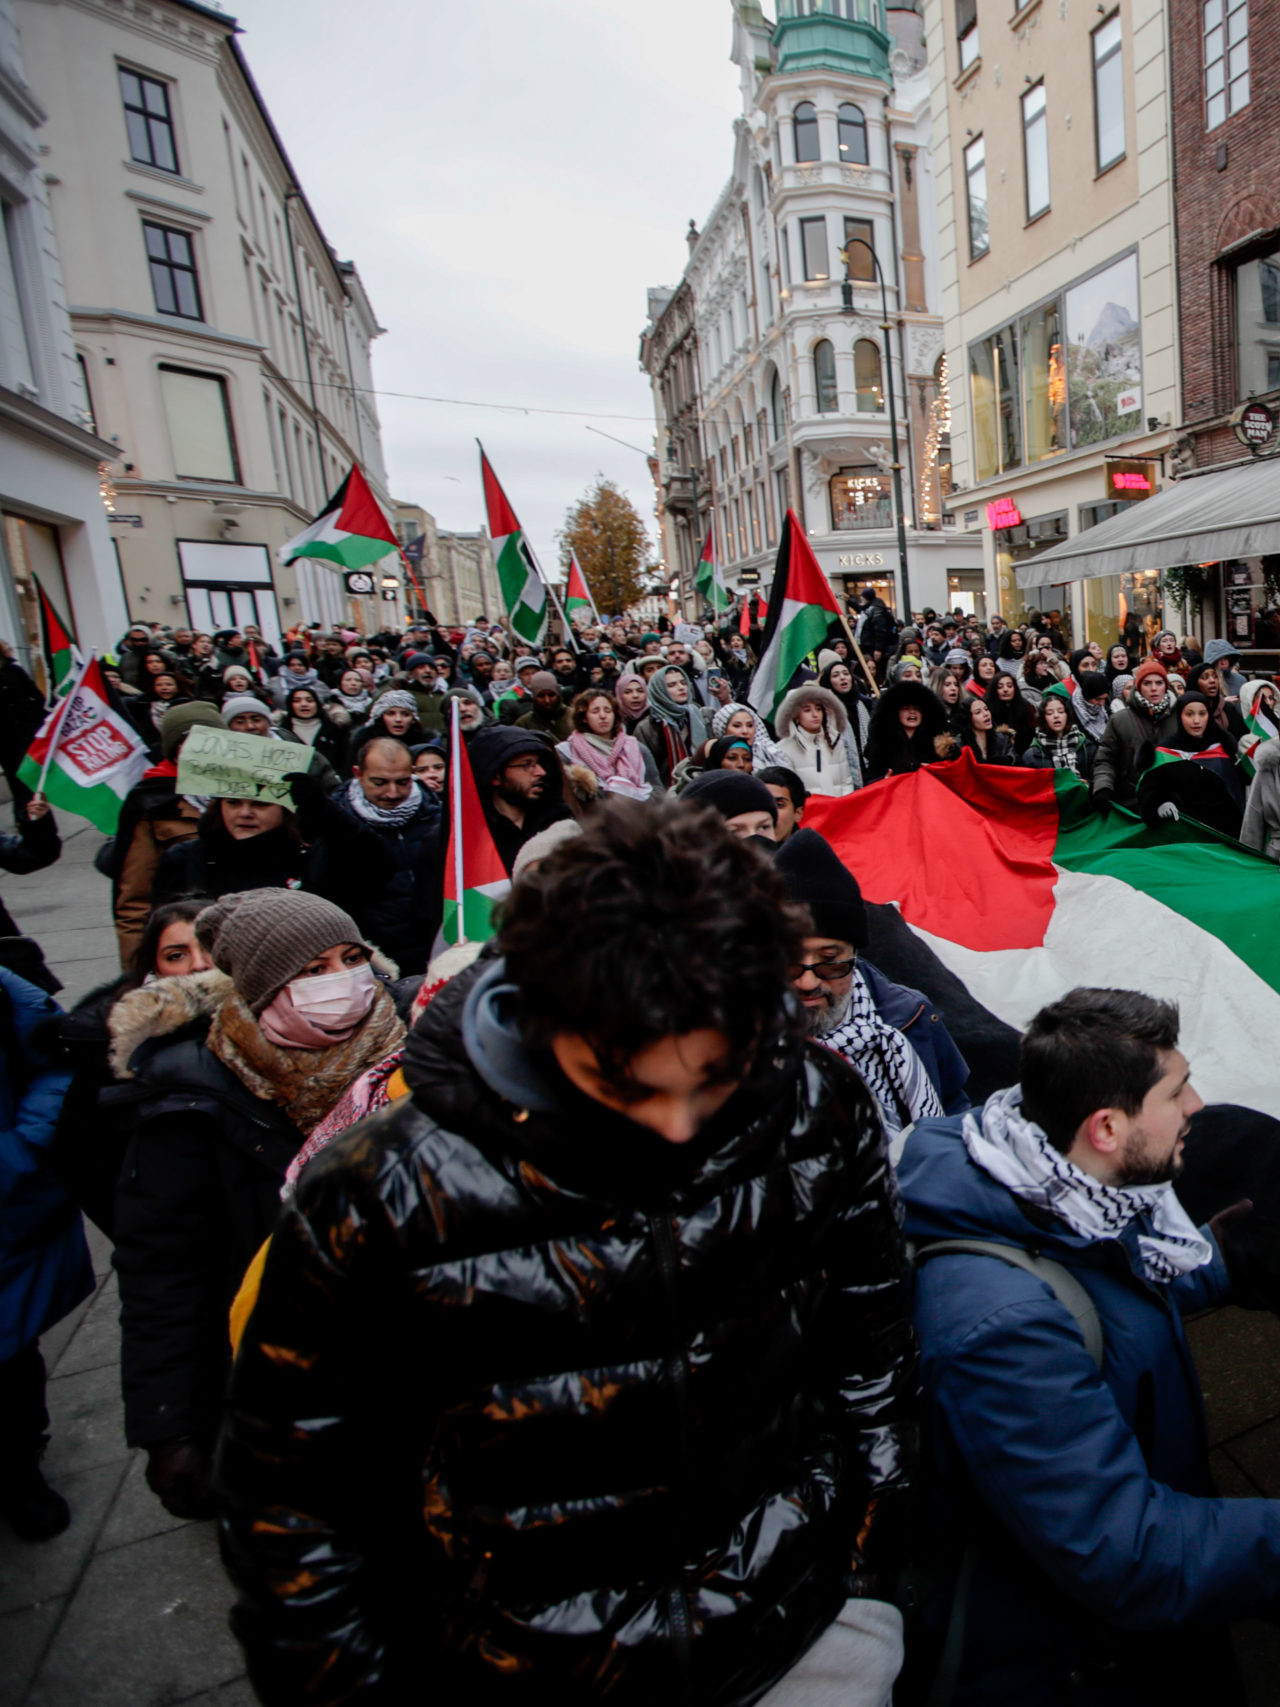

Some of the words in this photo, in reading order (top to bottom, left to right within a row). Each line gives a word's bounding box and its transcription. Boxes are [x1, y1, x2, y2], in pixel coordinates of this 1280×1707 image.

[1248, 412, 1266, 421] THE
[1244, 420, 1272, 432] SCOTS
[1247, 429, 1268, 441] MAN
[847, 478, 878, 487] KICKS
[839, 552, 884, 566] KICKS
[67, 726, 113, 761] STOP
